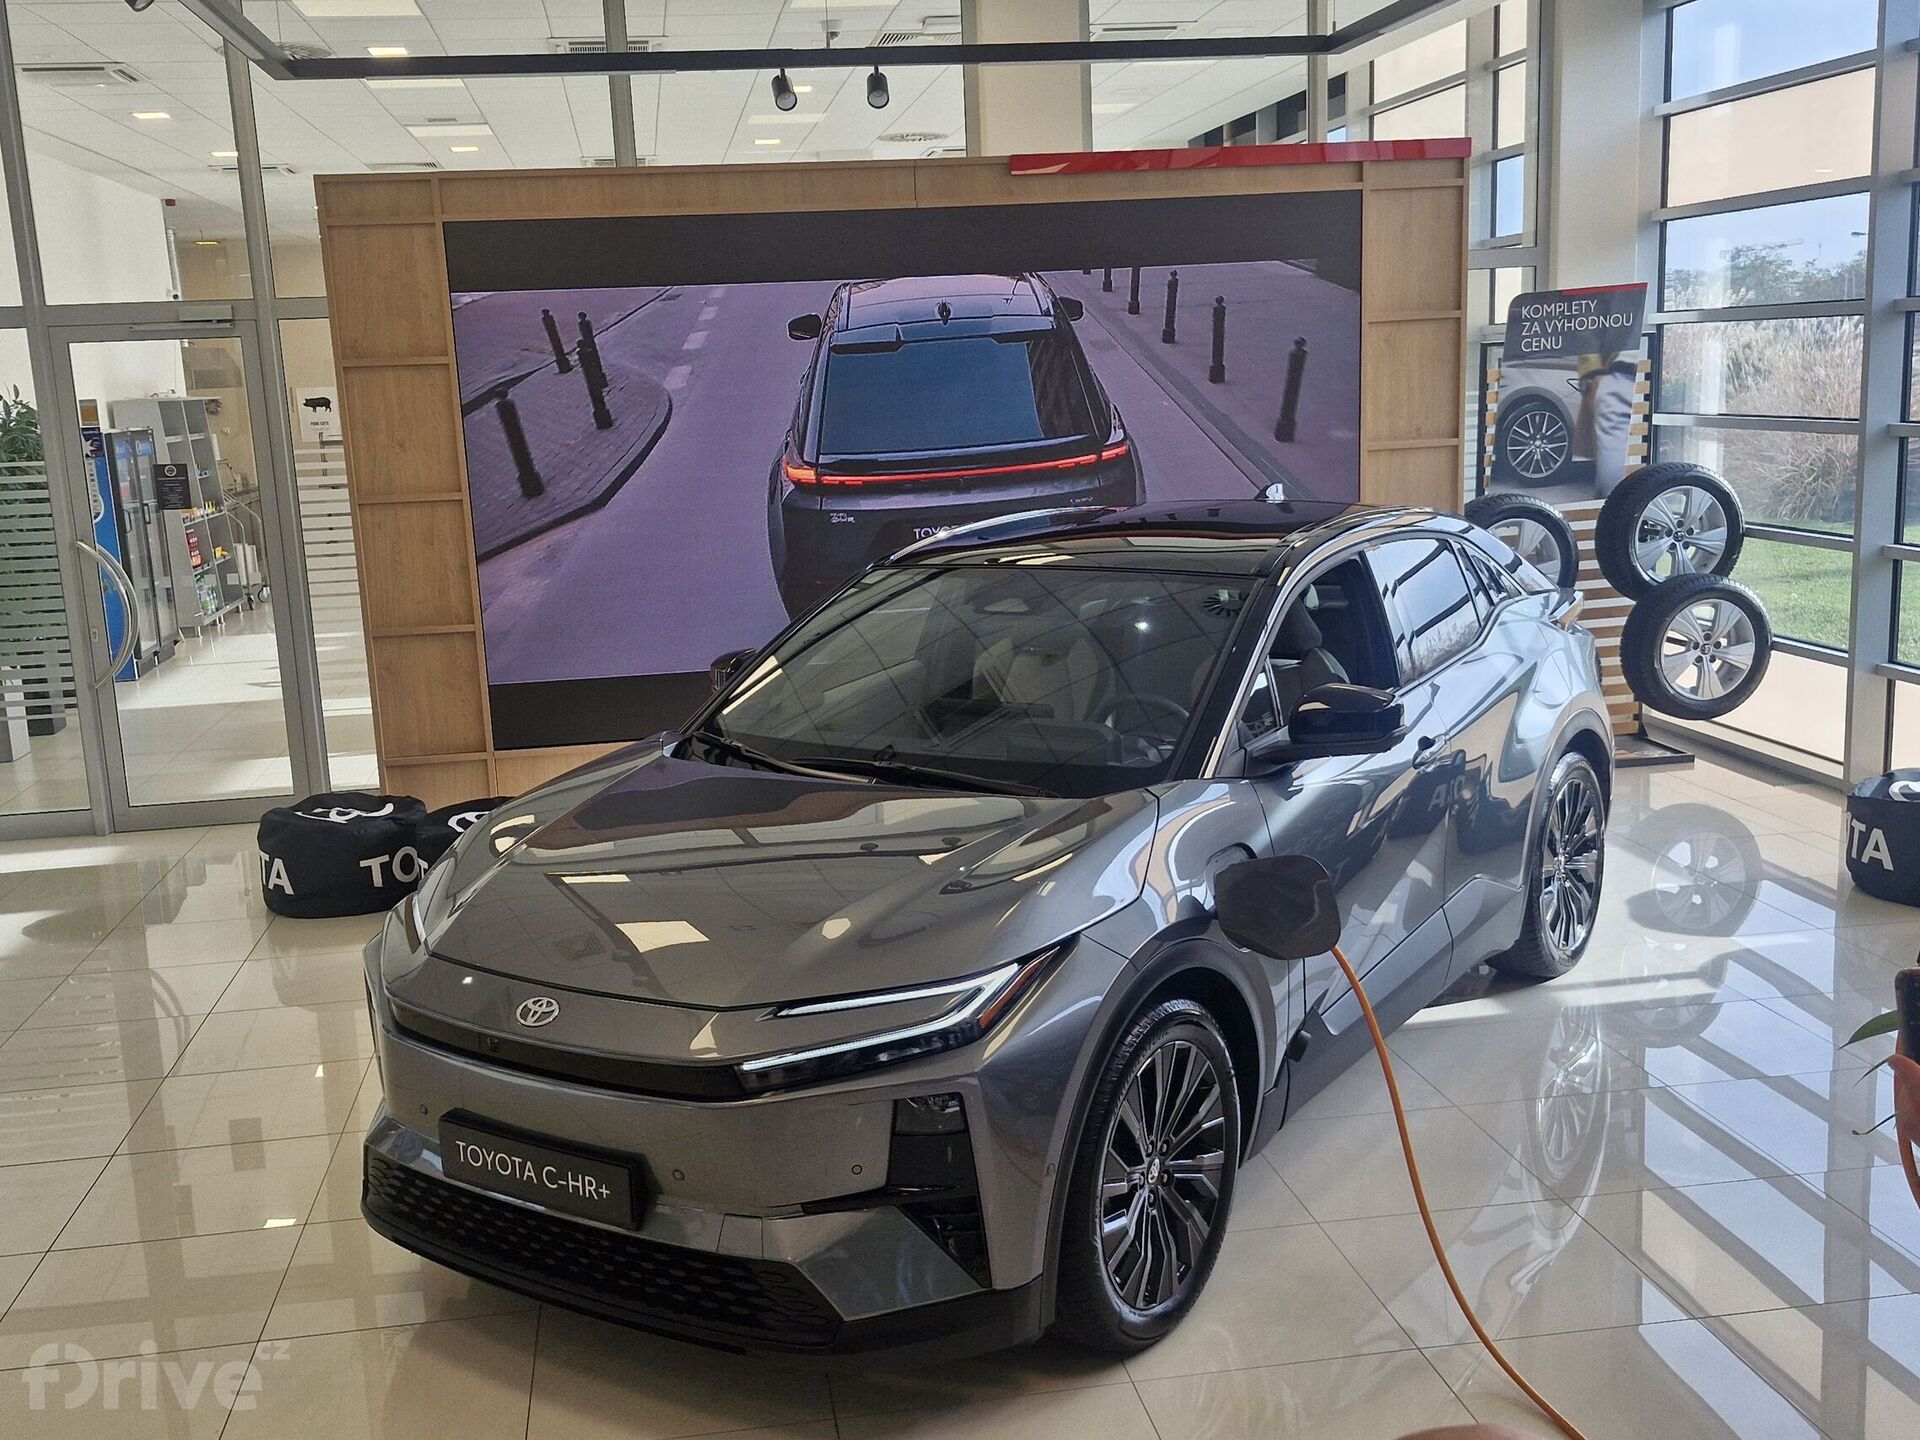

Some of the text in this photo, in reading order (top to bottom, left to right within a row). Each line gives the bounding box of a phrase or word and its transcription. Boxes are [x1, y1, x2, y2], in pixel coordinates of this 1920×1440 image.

[1521, 299, 1598, 319] KOMPLETY
[1521, 312, 1633, 336] ZA VÝHODNOU
[1521, 336, 1562, 352] CENU
[1846, 811, 1894, 871] TA
[456, 1140, 611, 1200] TOYOTA C-HR+
